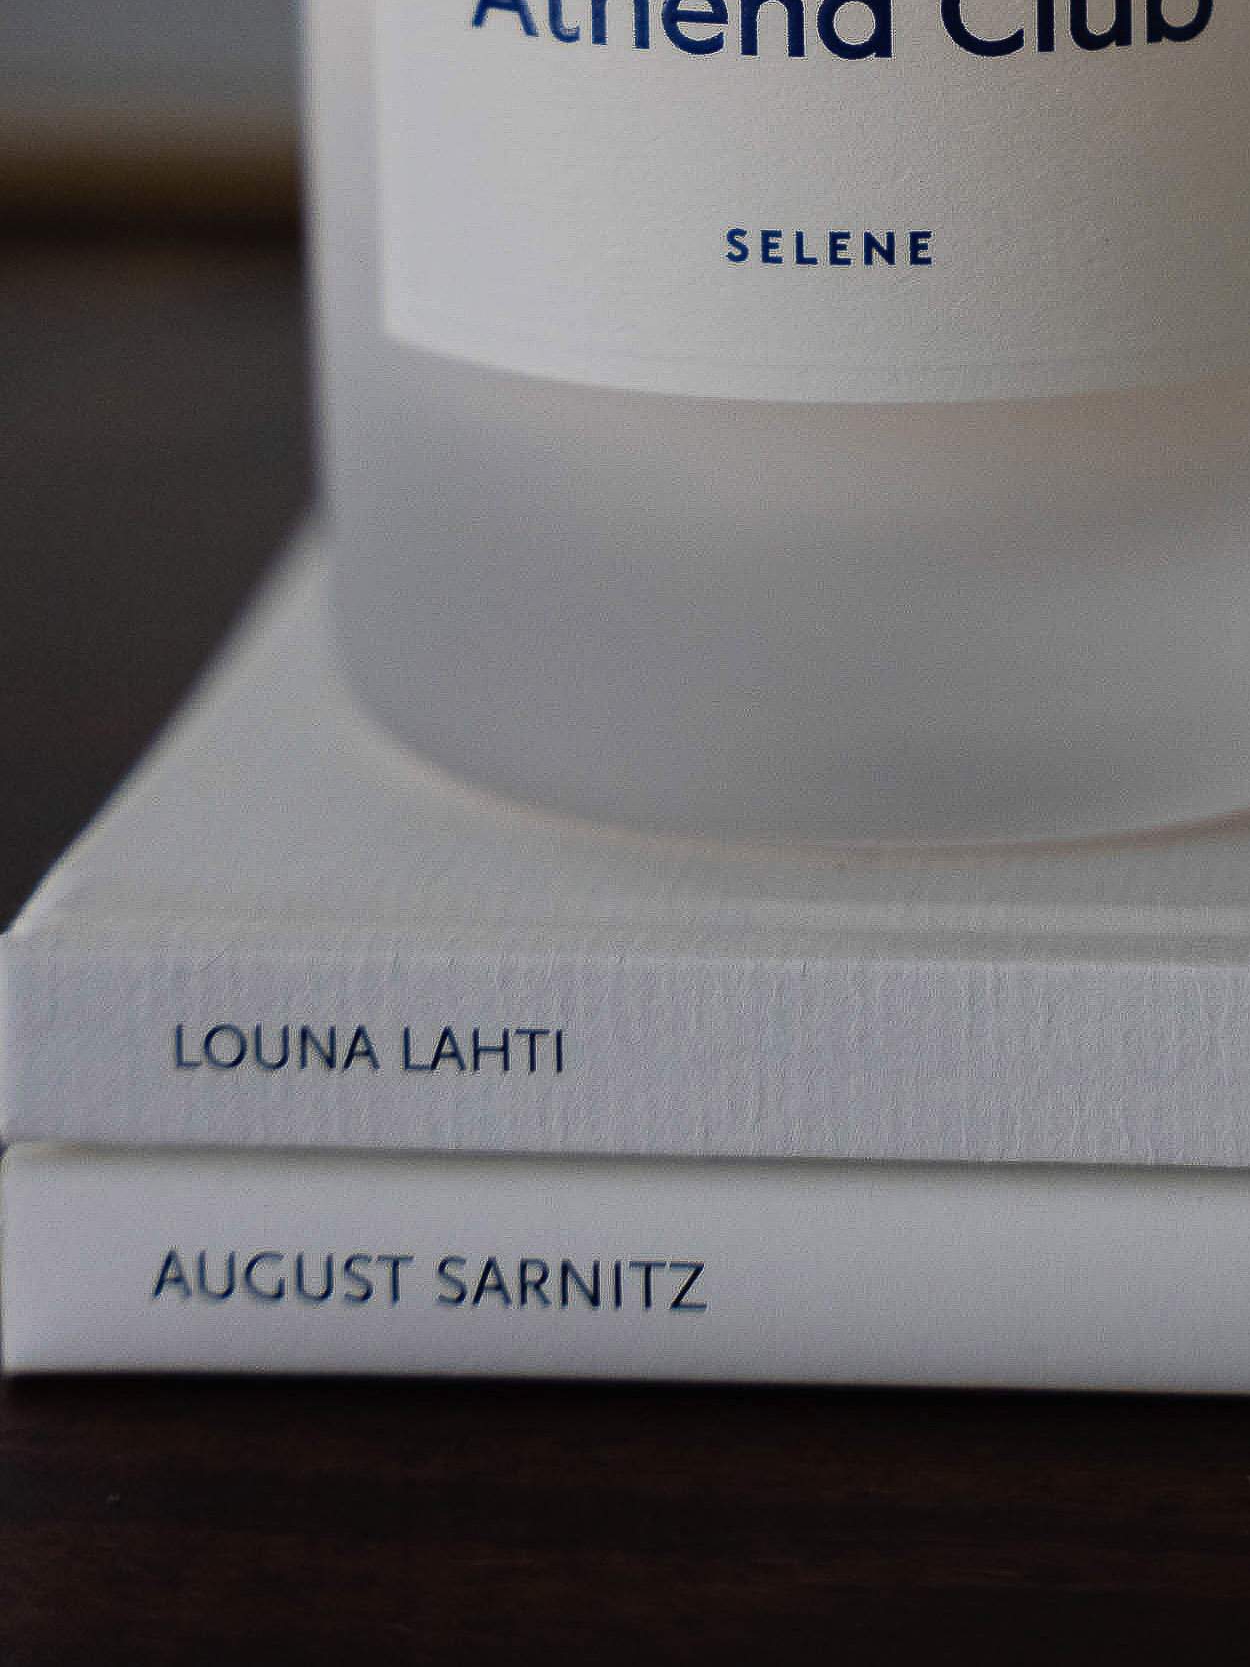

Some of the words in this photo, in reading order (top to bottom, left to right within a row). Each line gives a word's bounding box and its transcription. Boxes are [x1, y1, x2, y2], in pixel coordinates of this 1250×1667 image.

[724, 226, 934, 267] SELENE
[174, 1023, 381, 1074] LOUNA
[401, 1025, 565, 1075] LAHTI
[151, 1248, 414, 1306] AUGUST
[435, 1255, 709, 1312] SARNITZ
